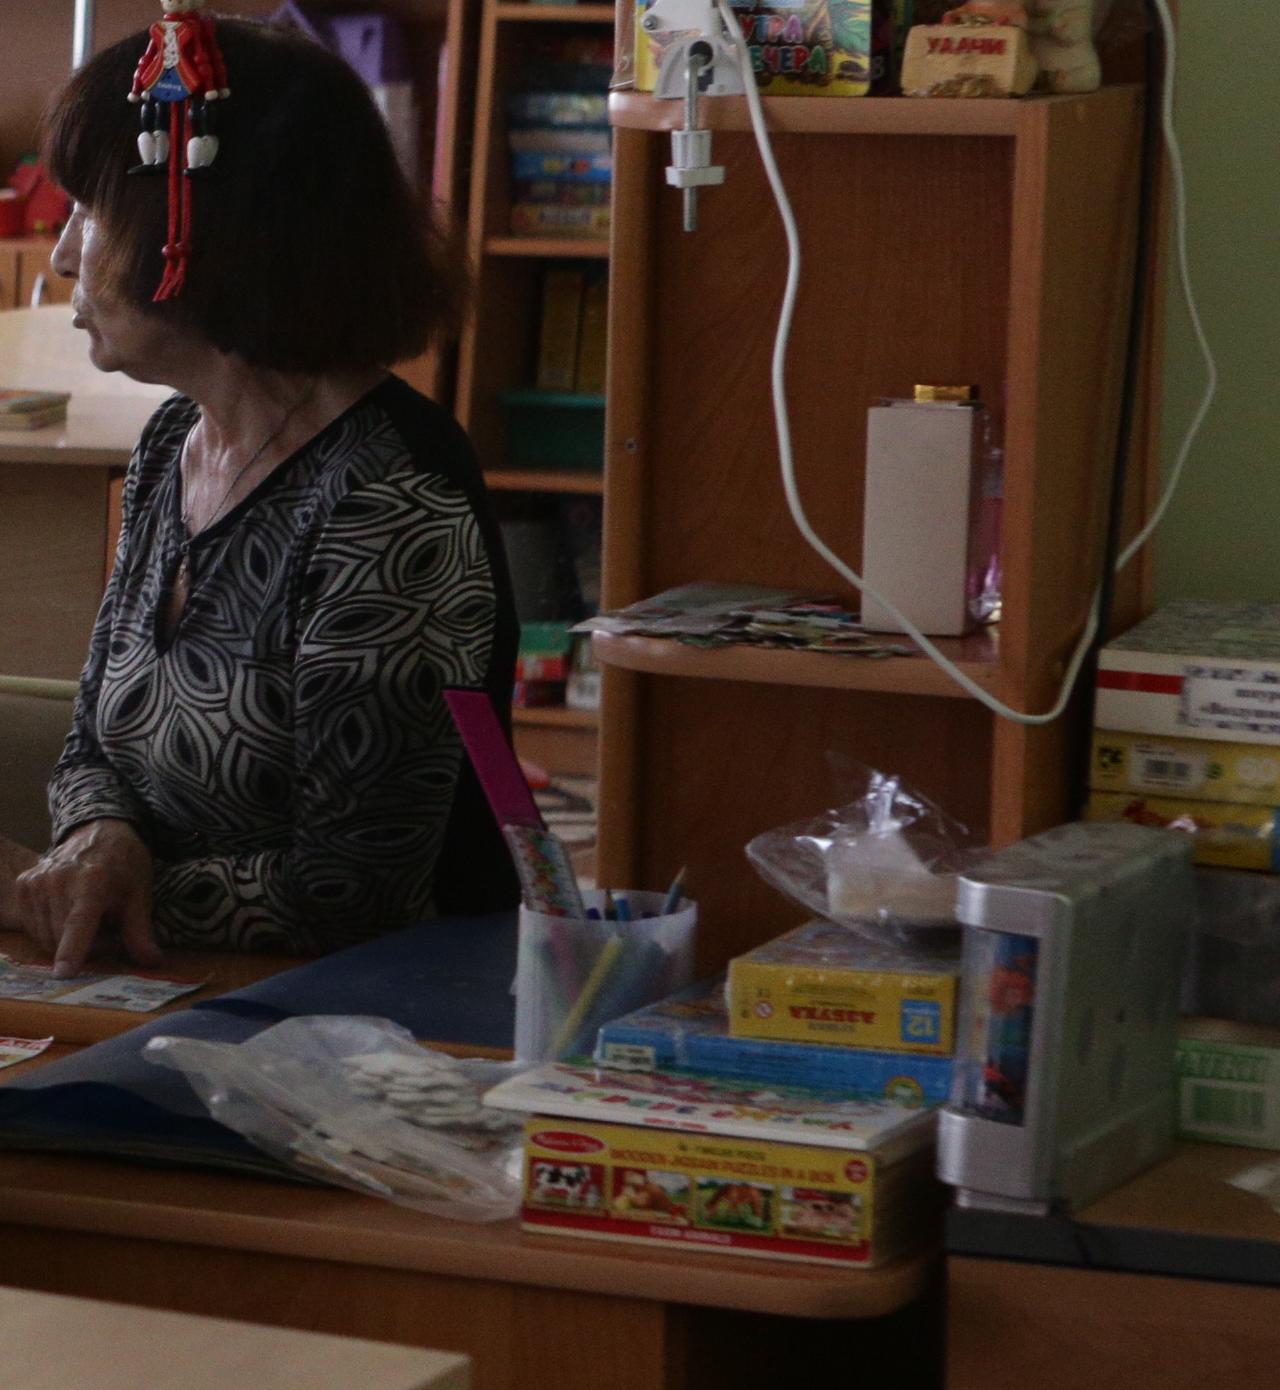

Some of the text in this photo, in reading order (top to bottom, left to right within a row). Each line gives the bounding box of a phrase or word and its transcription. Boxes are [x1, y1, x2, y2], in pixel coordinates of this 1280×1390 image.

[739, 14, 803, 43] УТРА
[749, 45, 826, 73] ЕЧЕРА
[927, 37, 1007, 54] УДАЧИ
